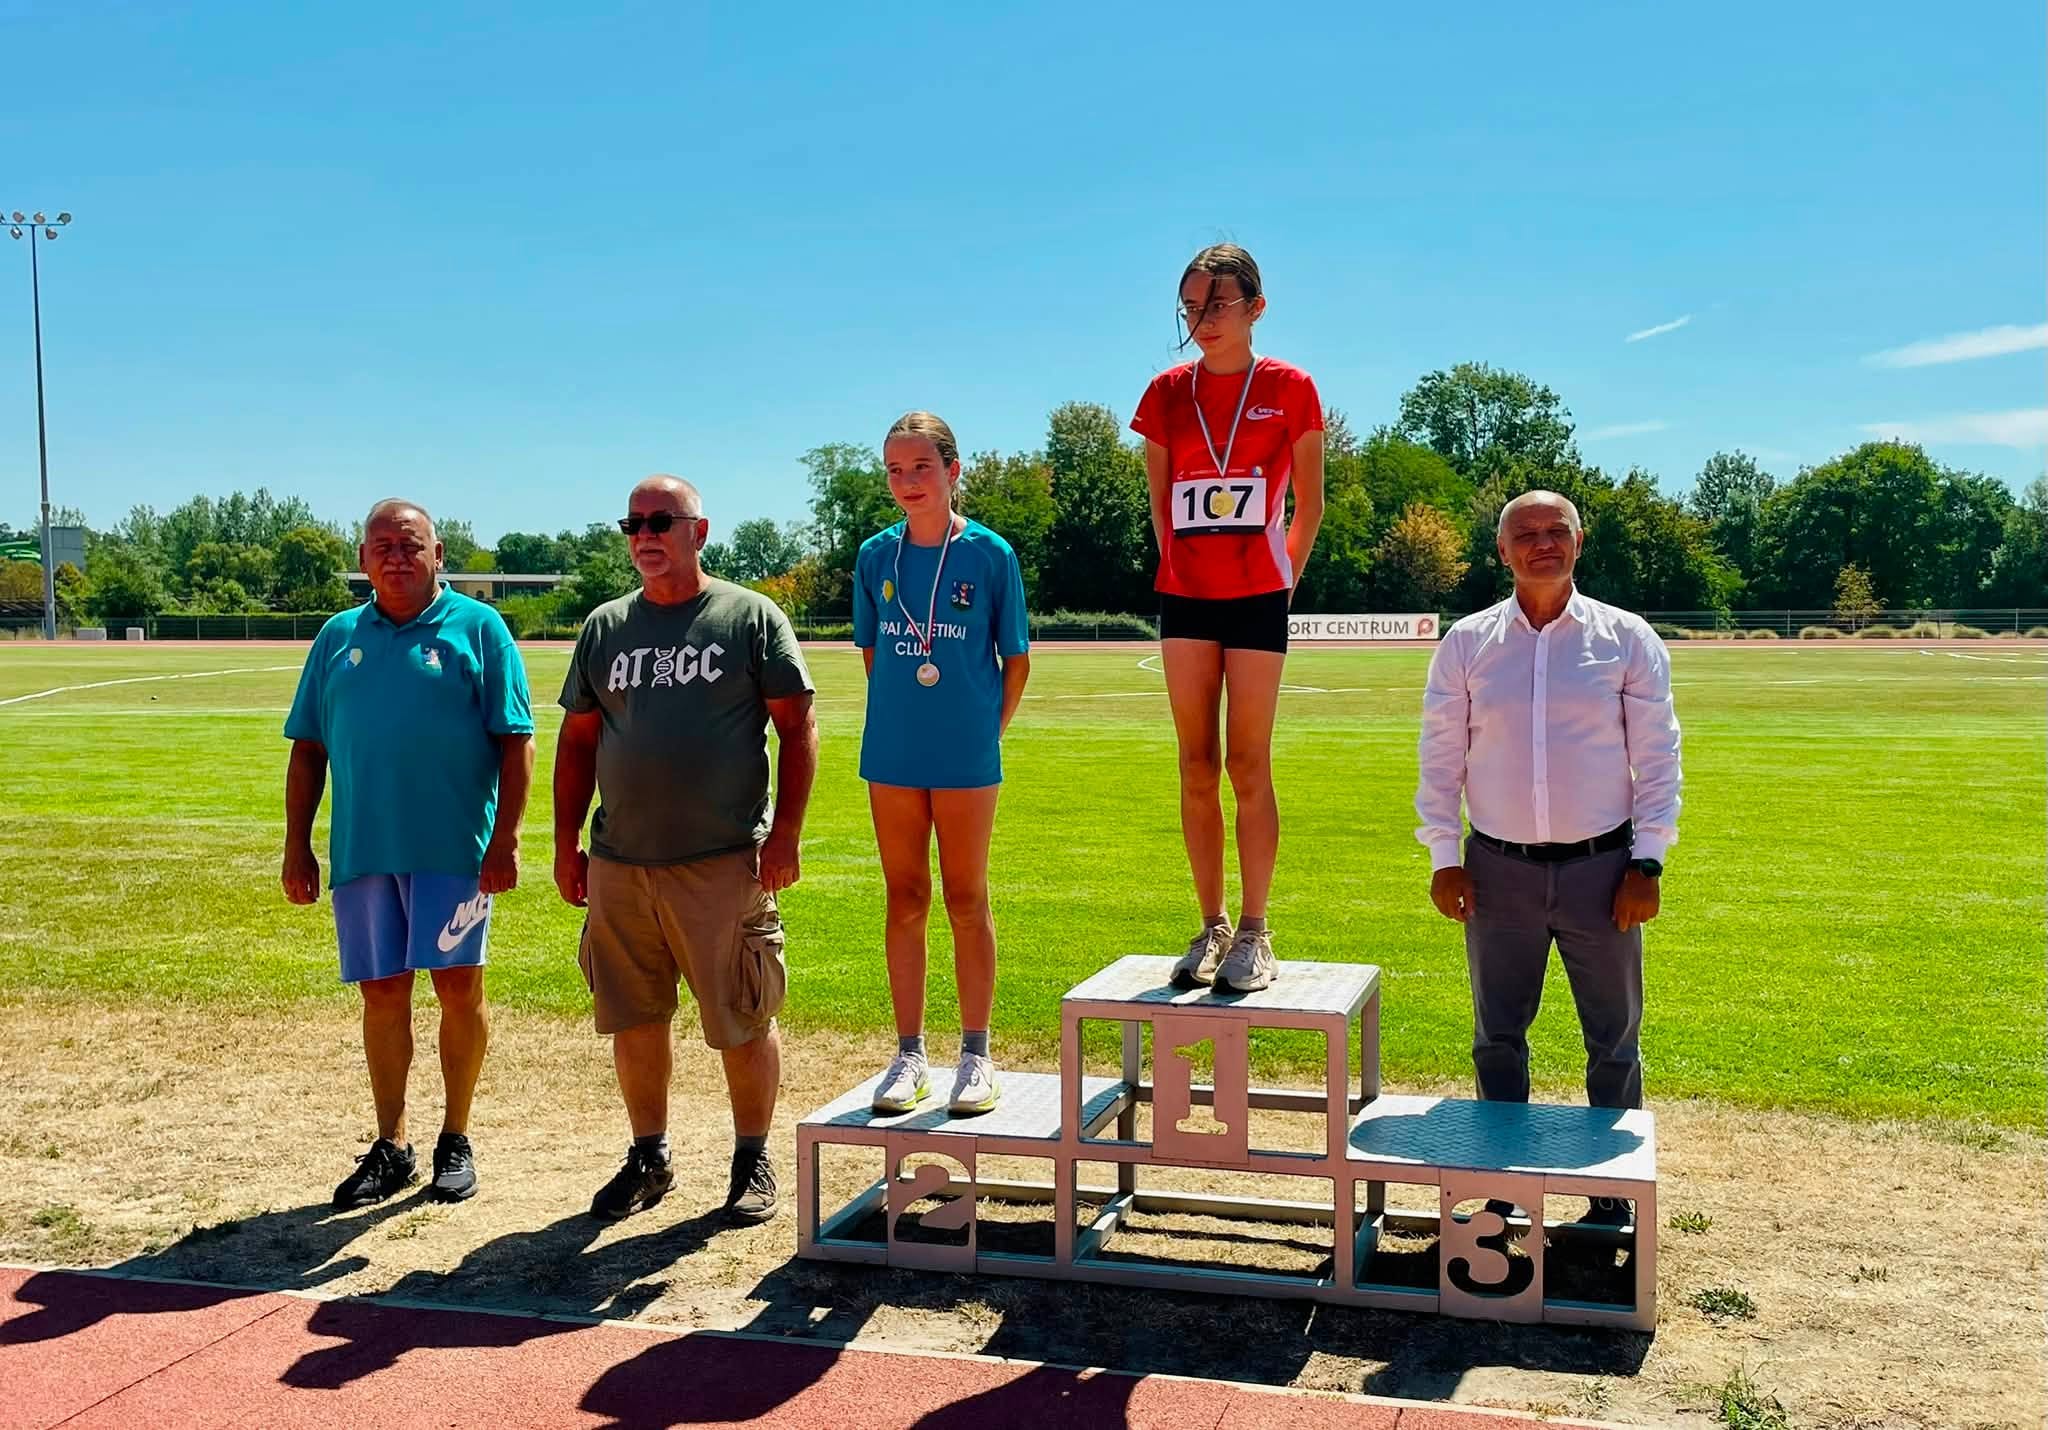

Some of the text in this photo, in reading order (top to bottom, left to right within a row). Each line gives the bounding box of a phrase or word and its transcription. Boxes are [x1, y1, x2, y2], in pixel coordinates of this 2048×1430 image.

[1183, 485, 1254, 521] 107
[1326, 620, 1409, 635] CENTRUM
[1172, 1037, 1228, 1135] 1
[894, 1152, 972, 1246] 2
[1446, 1198, 1535, 1298] 3
